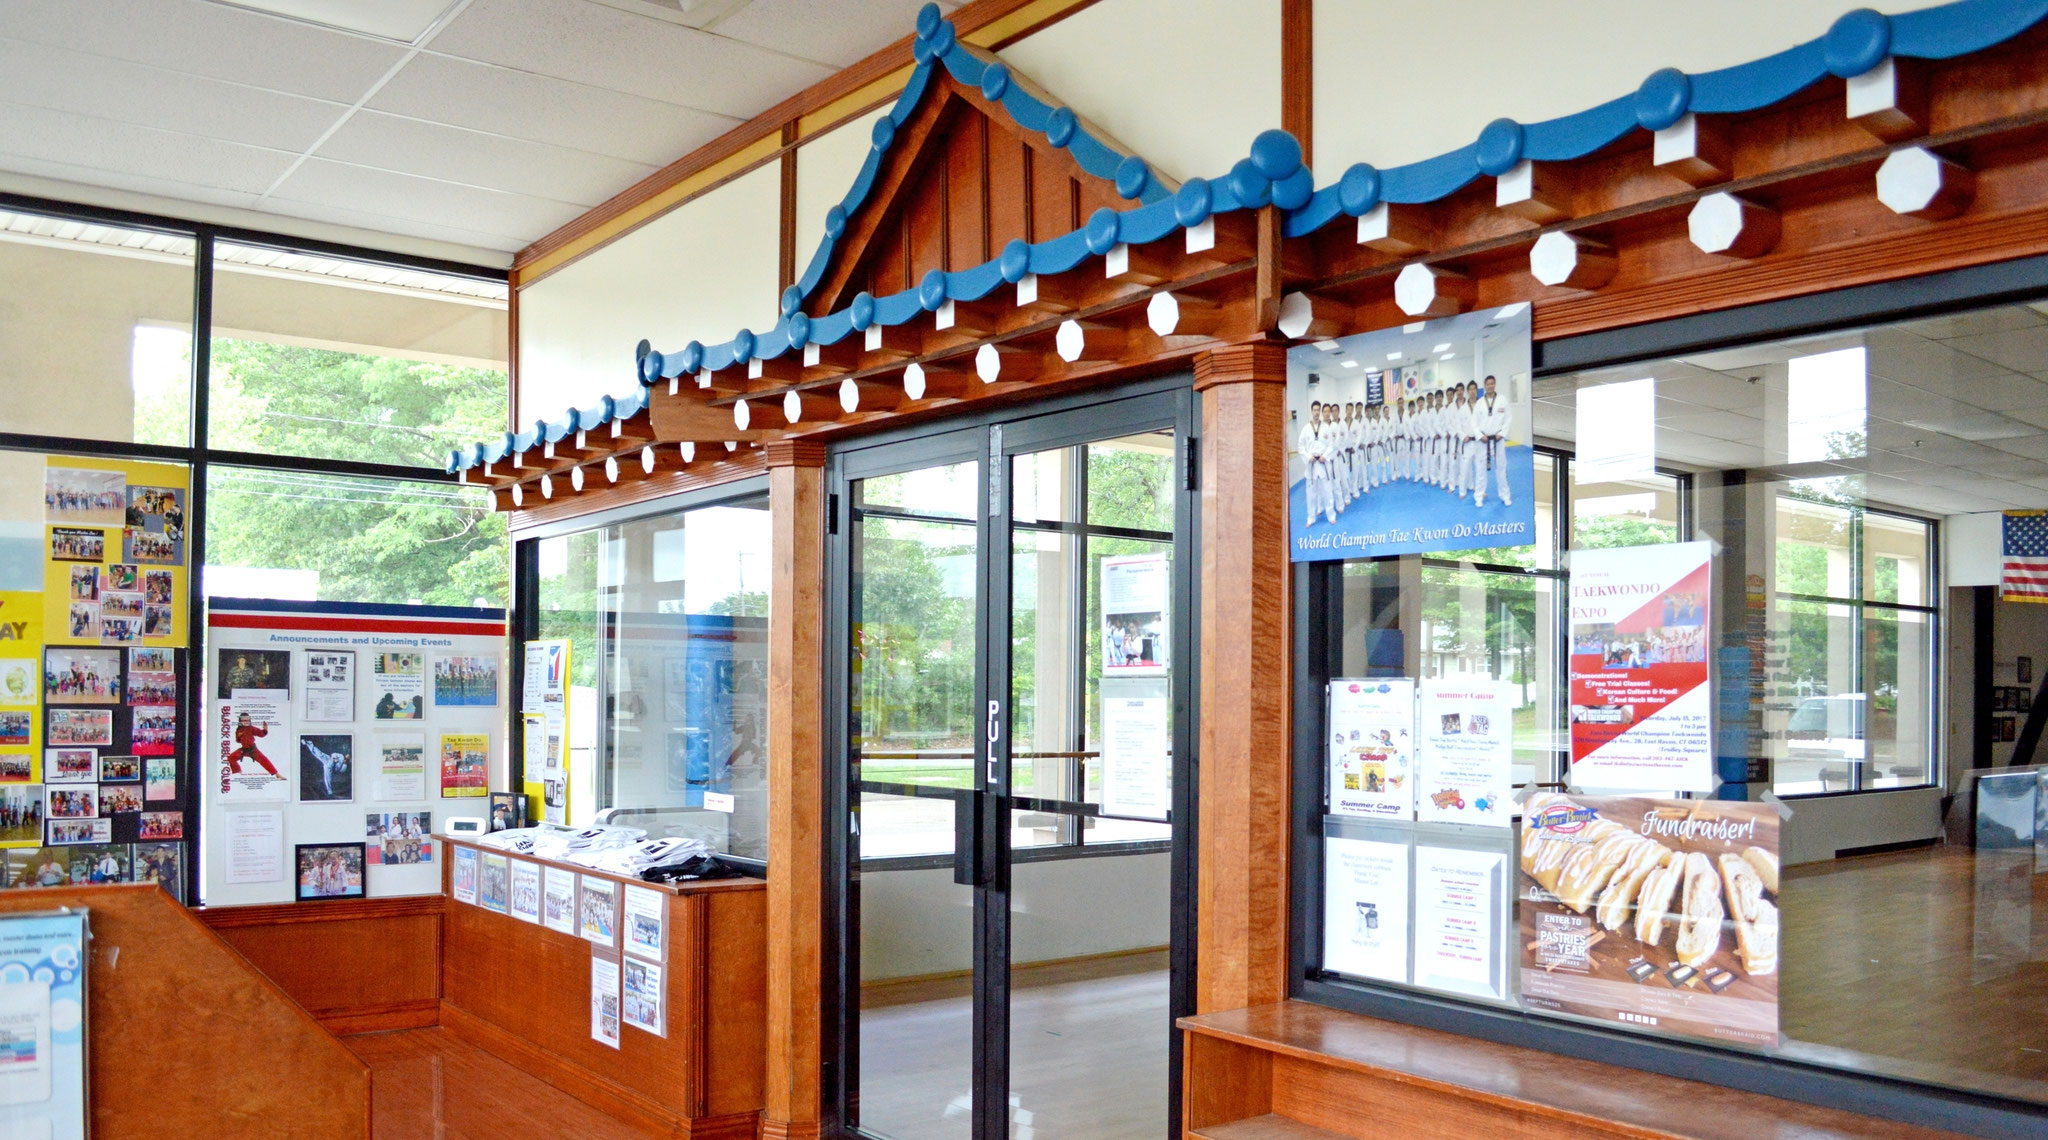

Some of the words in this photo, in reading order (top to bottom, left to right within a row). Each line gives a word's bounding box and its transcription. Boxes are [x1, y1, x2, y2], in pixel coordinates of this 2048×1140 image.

[1297, 533, 1331, 549] World
[1332, 531, 1386, 549] Champion
[1388, 527, 1410, 544] Tae
[1412, 526, 1449, 543] Kwon
[1451, 523, 1471, 538] Do
[1473, 520, 1525, 536] Masters
[1572, 583, 1660, 597] TAEKWONDO
[1572, 607, 1607, 618] EXPO
[270, 634, 349, 645] Announcements
[352, 637, 369, 645] and
[372, 637, 418, 648] Upcoming
[421, 638, 452, 646] Events
[220, 705, 231, 739] BLACK
[1640, 730, 1670, 738] Champion
[987, 700, 1000, 784] PULL
[220, 766, 231, 794] CLUB
[1341, 799, 1375, 808] Summer
[1377, 803, 1401, 811] Camp
[1641, 809, 1756, 841] Fundraiser!
[1545, 915, 1570, 924] ENTER
[1571, 918, 1582, 926] TO
[1540, 931, 1586, 946] PASTRIES
[1558, 944, 1585, 956] YEAR
[1714, 1027, 1771, 1041] BUTTERBRAID.COM
